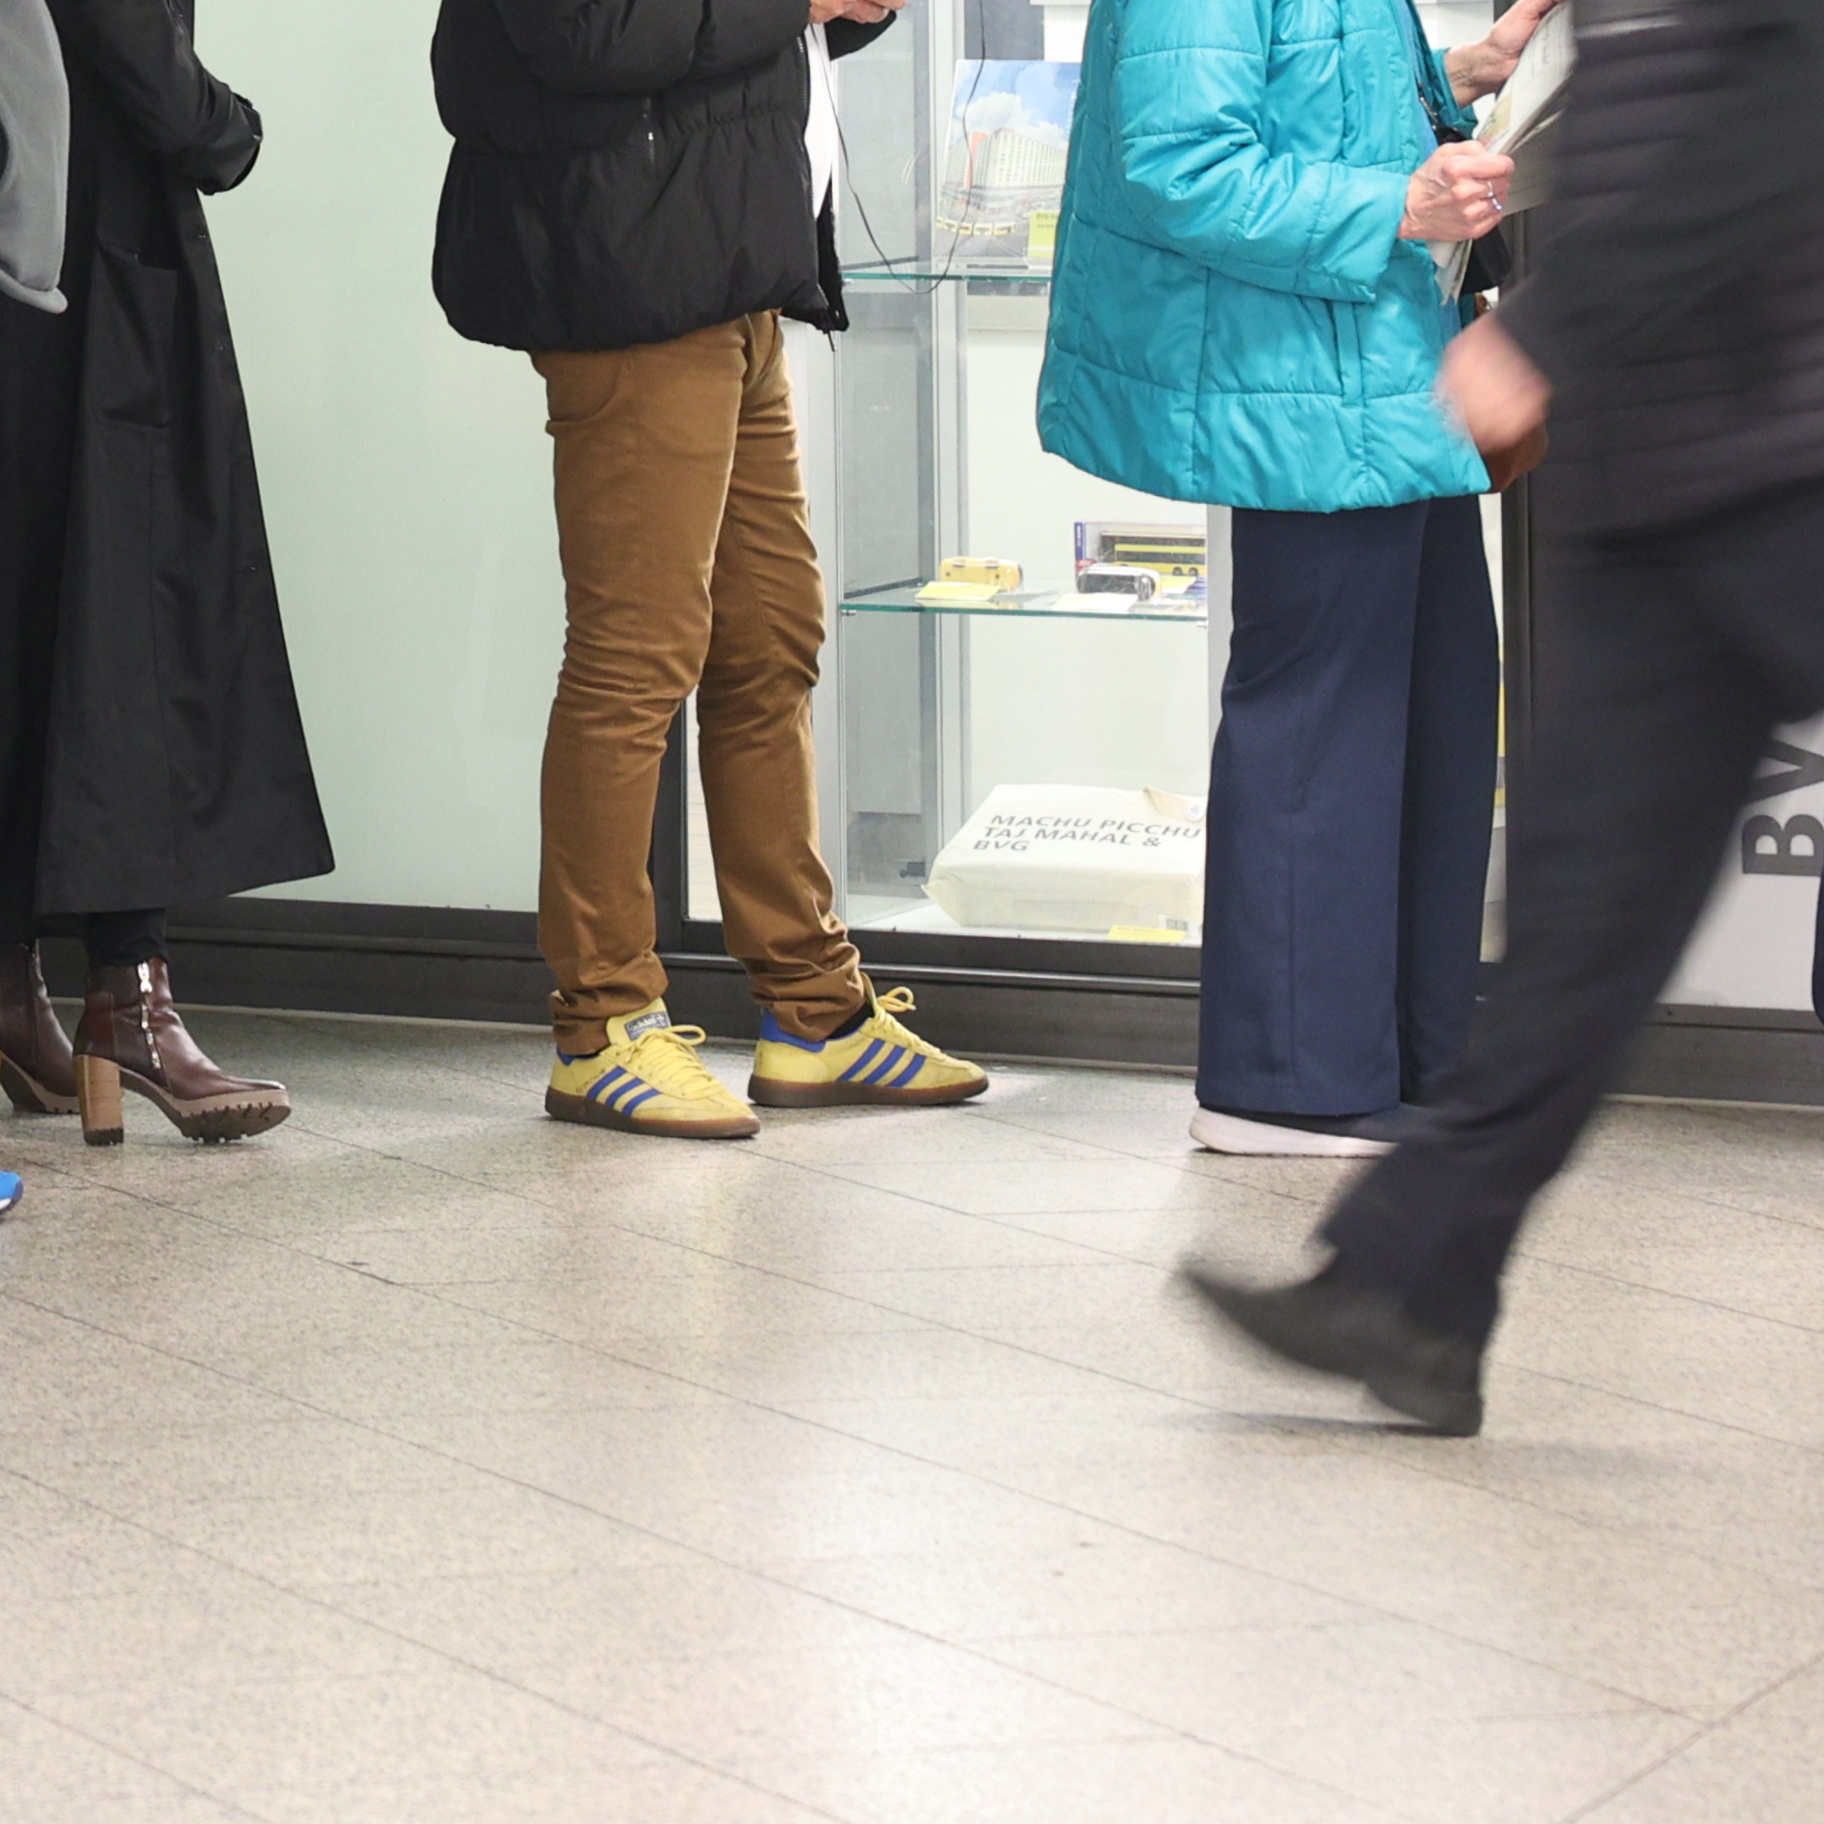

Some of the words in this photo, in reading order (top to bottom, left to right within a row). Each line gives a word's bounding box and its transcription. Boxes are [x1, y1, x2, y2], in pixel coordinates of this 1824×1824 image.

[984, 826, 1028, 839] TAJ
[1034, 828, 1132, 846] MAHAL
[1141, 836, 1162, 848] &
[990, 814, 1093, 828] MACHU
[1100, 819, 1201, 839] PICCHU
[972, 839, 1031, 852] BVG
